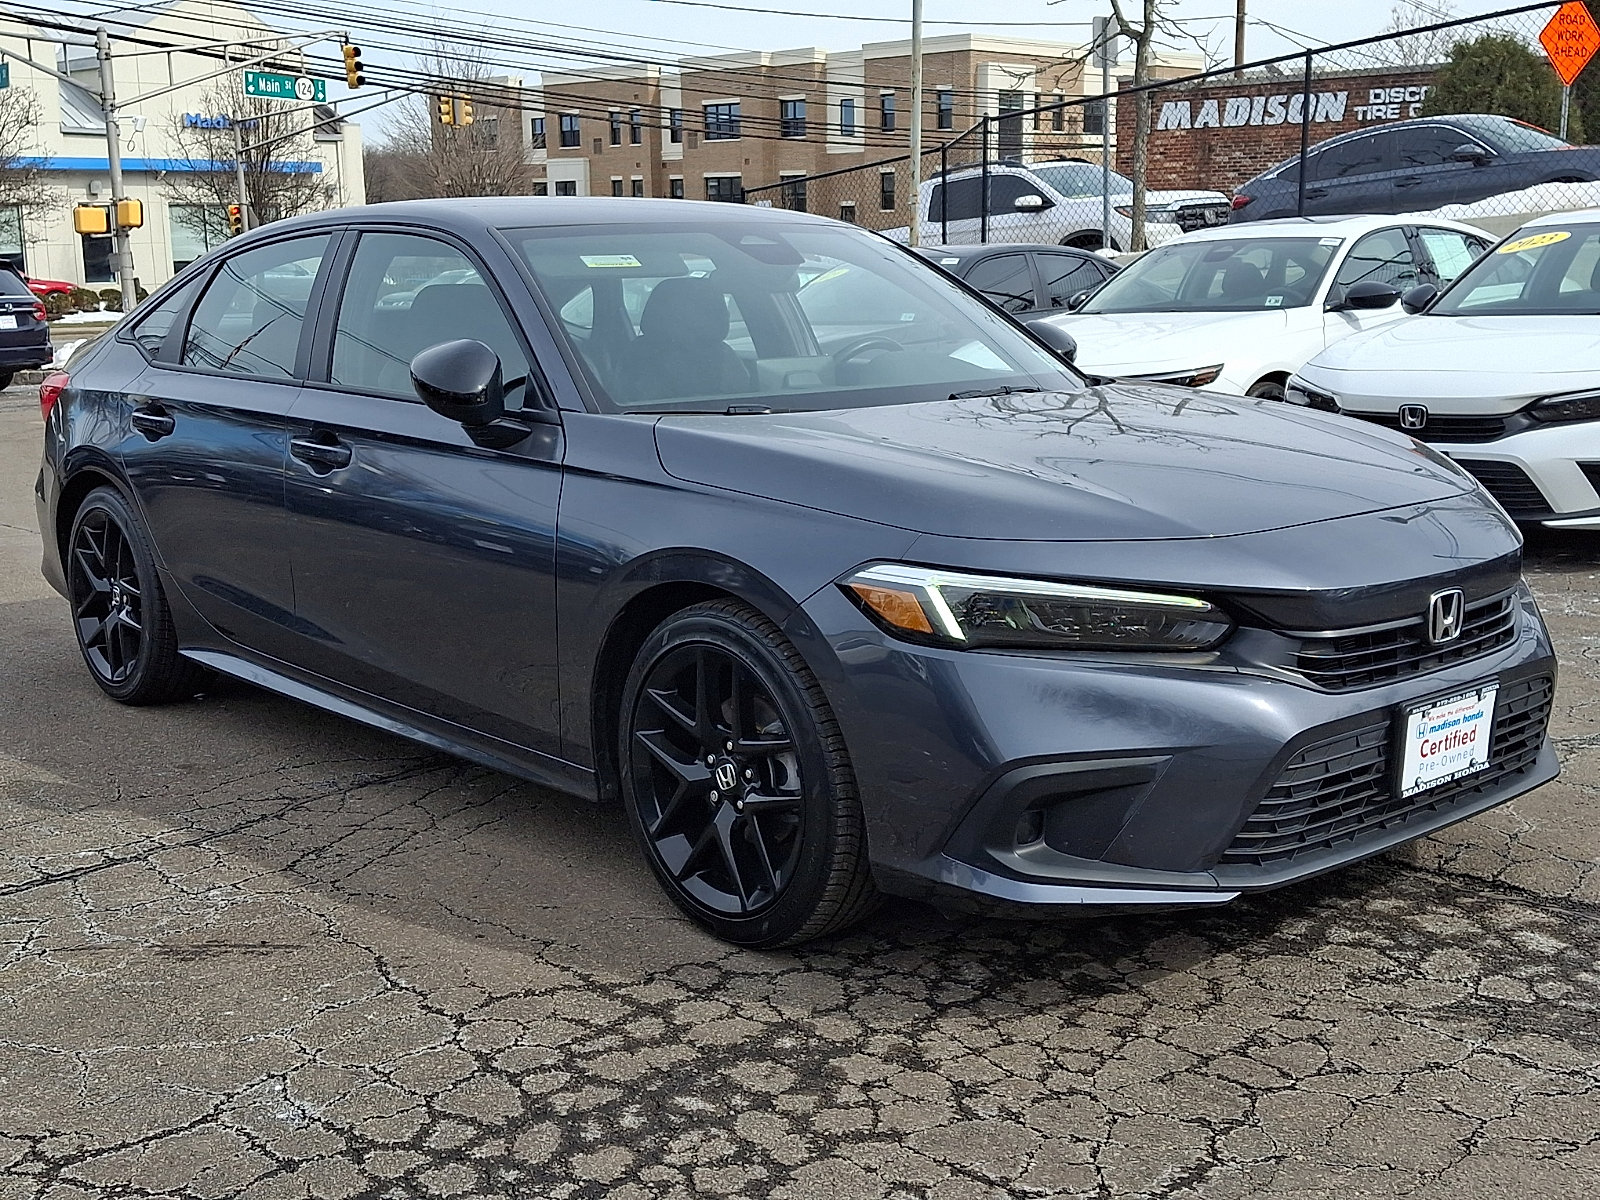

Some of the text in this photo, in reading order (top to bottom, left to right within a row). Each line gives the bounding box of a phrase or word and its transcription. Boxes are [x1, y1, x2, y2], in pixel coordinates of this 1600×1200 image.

[1559, 13, 1586, 26] ROAD
[1557, 29, 1584, 42] WORK
[1554, 45, 1588, 58] AHEAD
[258, 77, 281, 93] Main
[297, 82, 312, 96] 124
[1156, 91, 1349, 131] MADISON
[1353, 104, 1401, 121] TIRE
[1429, 709, 1484, 734] madison honda
[1420, 724, 1477, 758] Certified
[1419, 746, 1475, 775] Pre-Owned
[1402, 761, 1491, 799] MADISON HONDA
